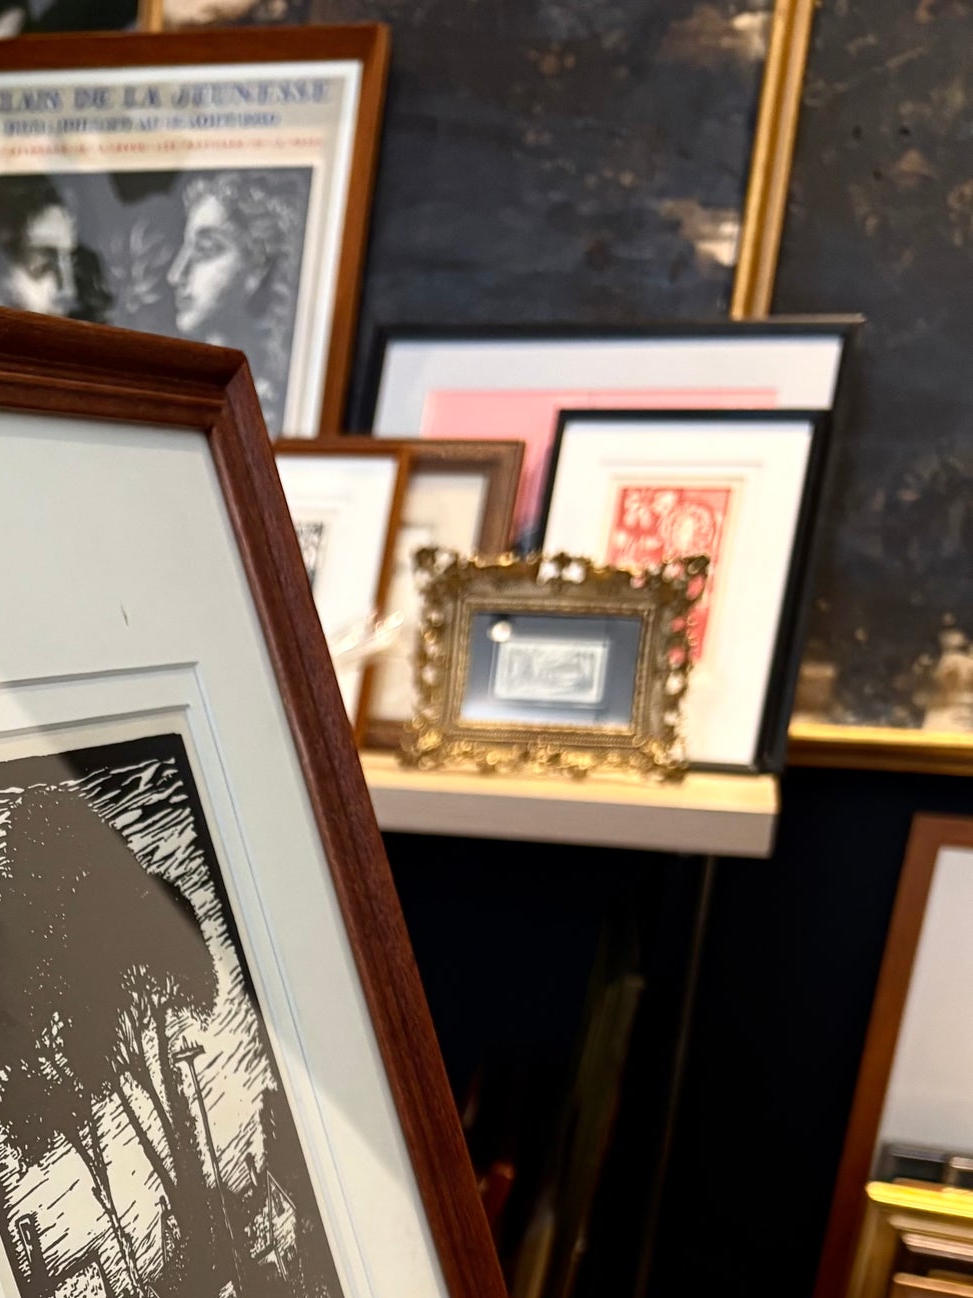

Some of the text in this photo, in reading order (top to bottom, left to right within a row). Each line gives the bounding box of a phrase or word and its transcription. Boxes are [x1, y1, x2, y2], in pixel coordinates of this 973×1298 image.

[74, 86, 110, 109] DE
[123, 84, 163, 108] LA
[171, 79, 327, 107] JEUNESSE
